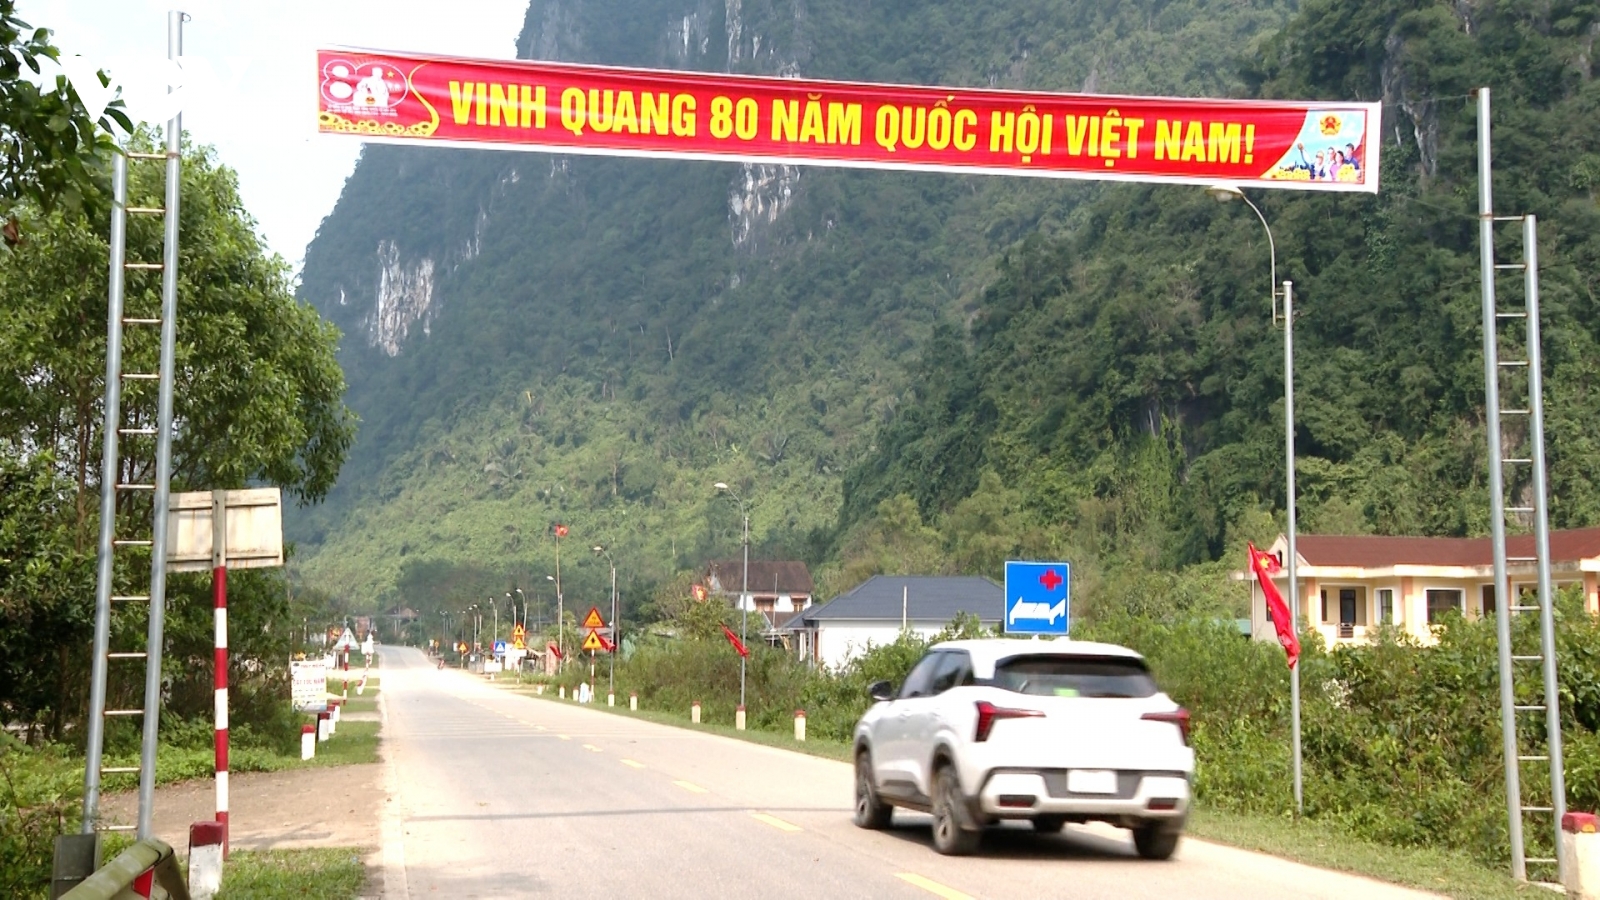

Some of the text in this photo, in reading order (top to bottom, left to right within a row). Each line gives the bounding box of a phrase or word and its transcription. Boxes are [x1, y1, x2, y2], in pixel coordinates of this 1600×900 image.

[447, 80, 1256, 167] VINH QUANG 80 NĂM QUỐC HỘI VIỆT NAM!
